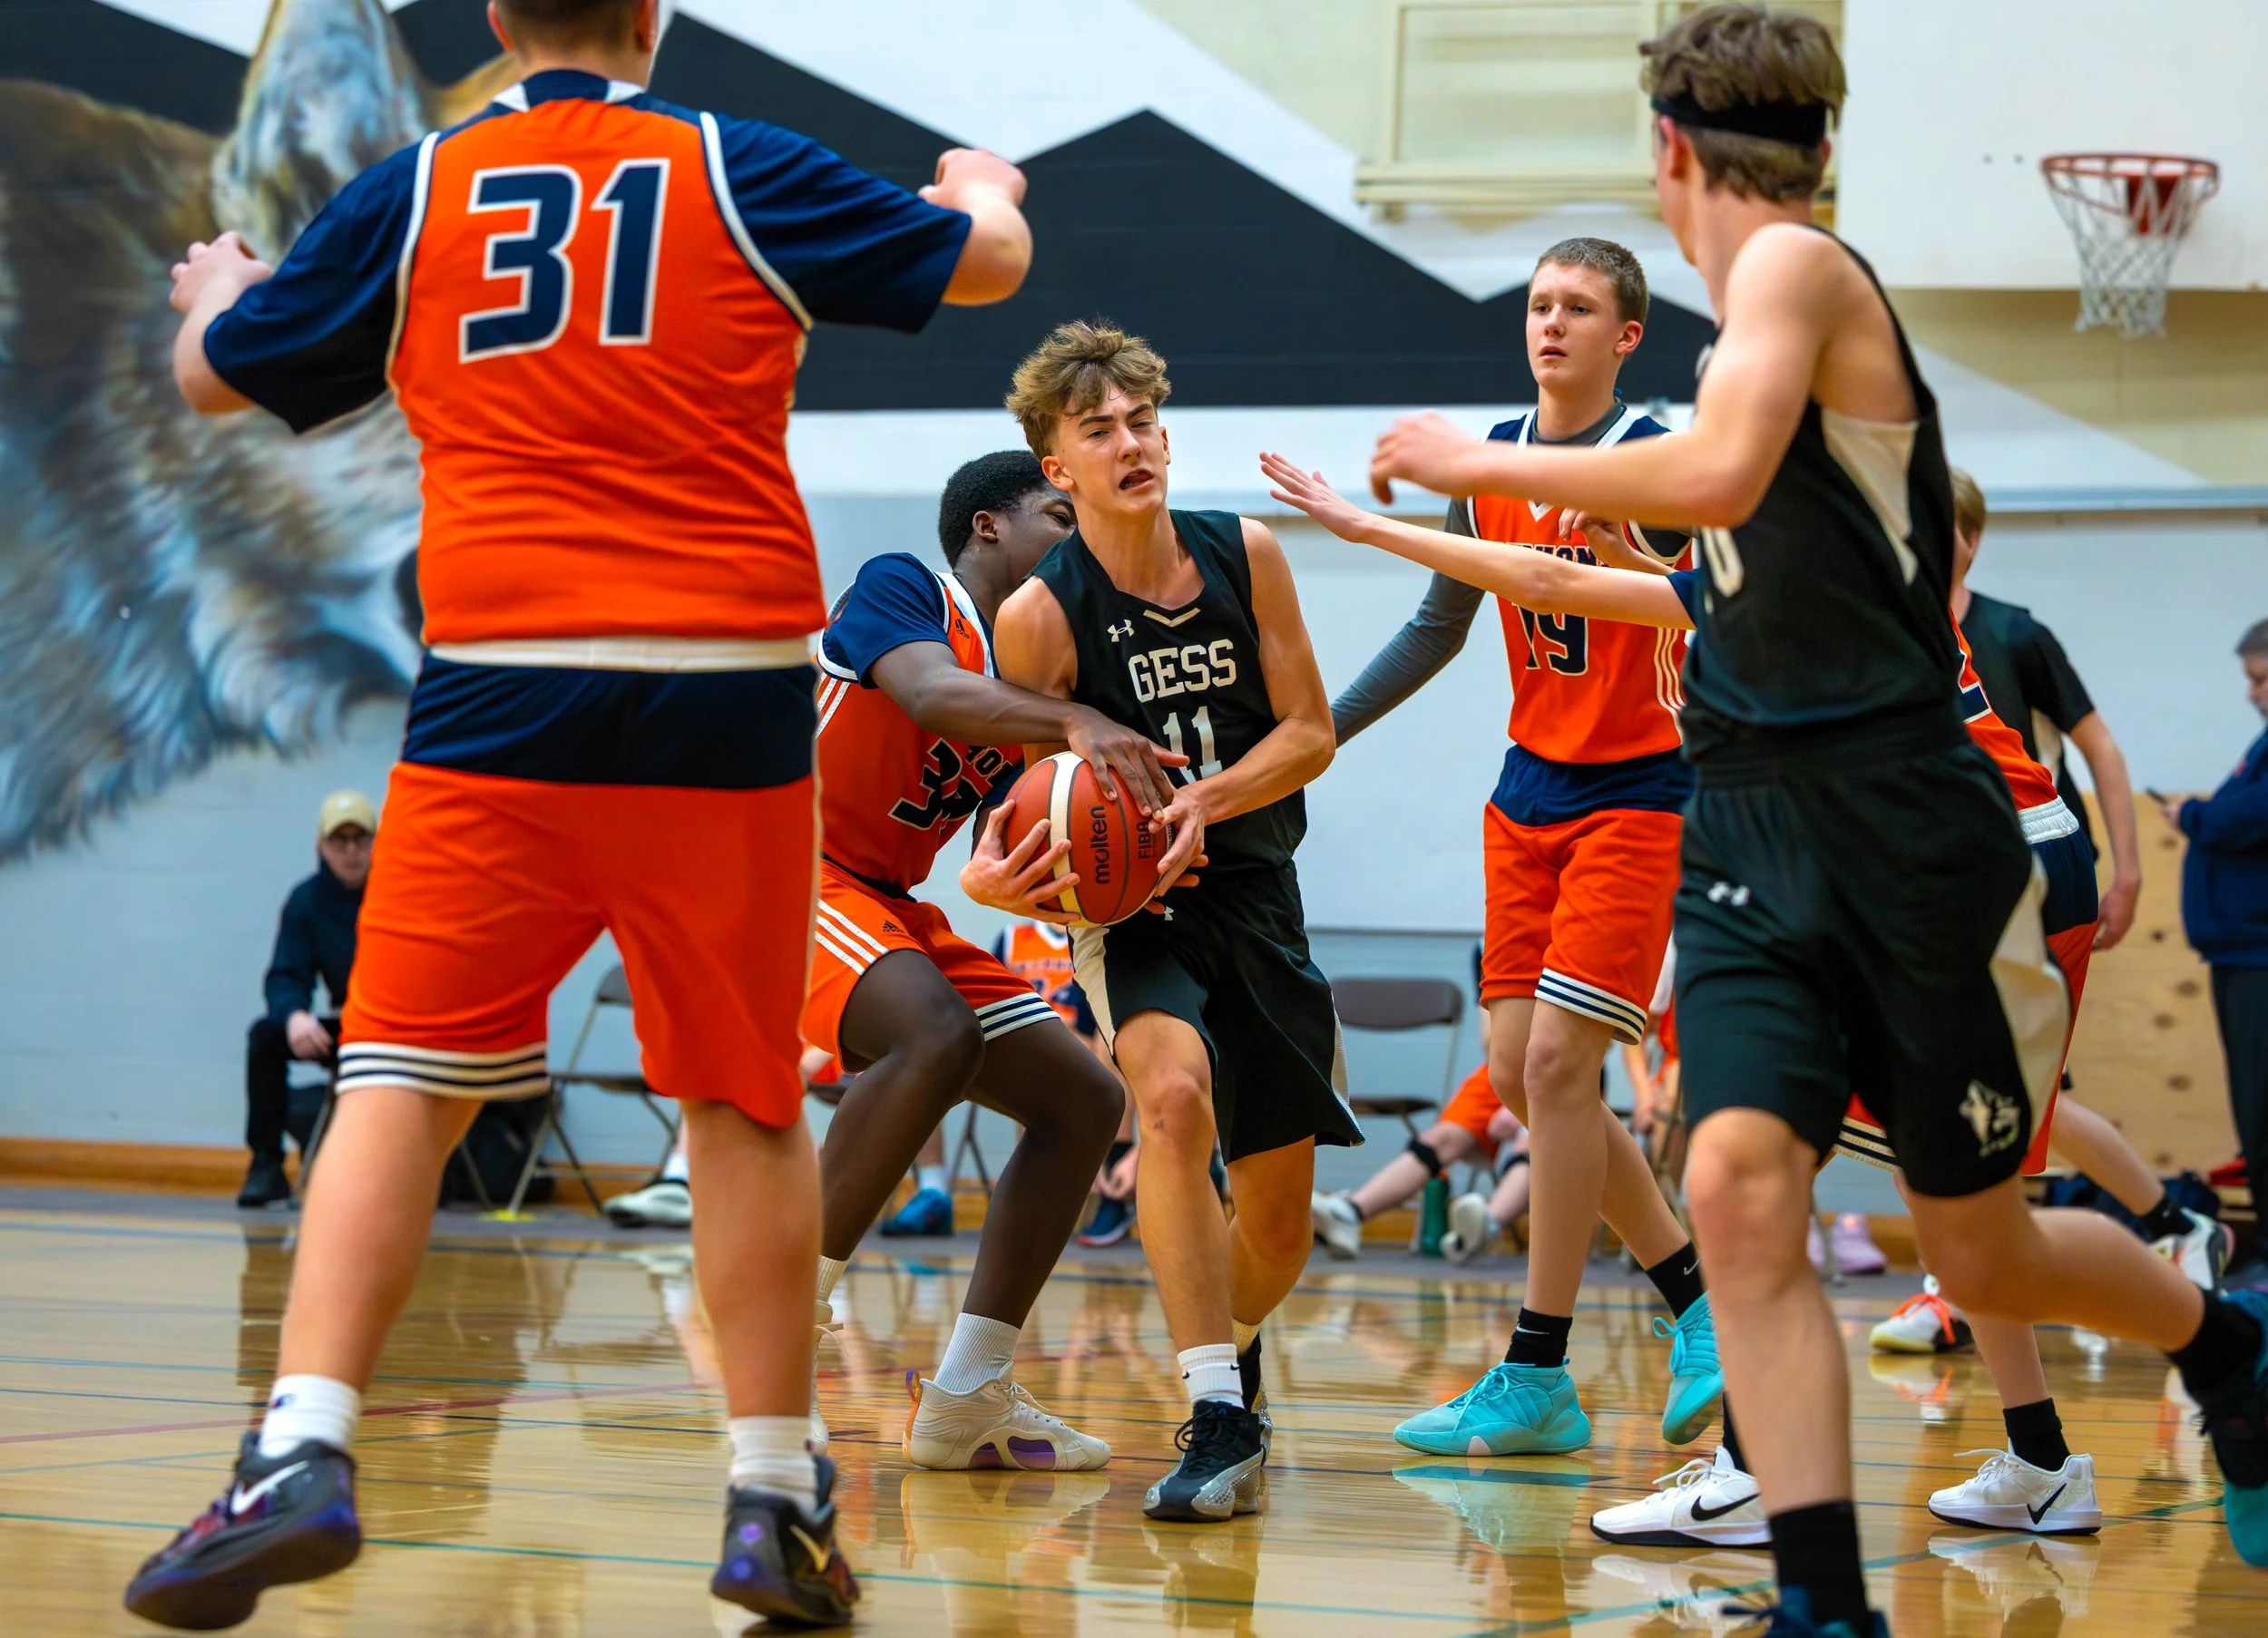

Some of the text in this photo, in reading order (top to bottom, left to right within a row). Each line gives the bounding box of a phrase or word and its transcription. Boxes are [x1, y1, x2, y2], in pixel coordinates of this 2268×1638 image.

[459, 157, 671, 364] 31
[1128, 639, 1237, 703] GESS
[1162, 706, 1224, 785] 11
[1090, 804, 1110, 884] molten
[1136, 820, 1150, 860] FIBA
